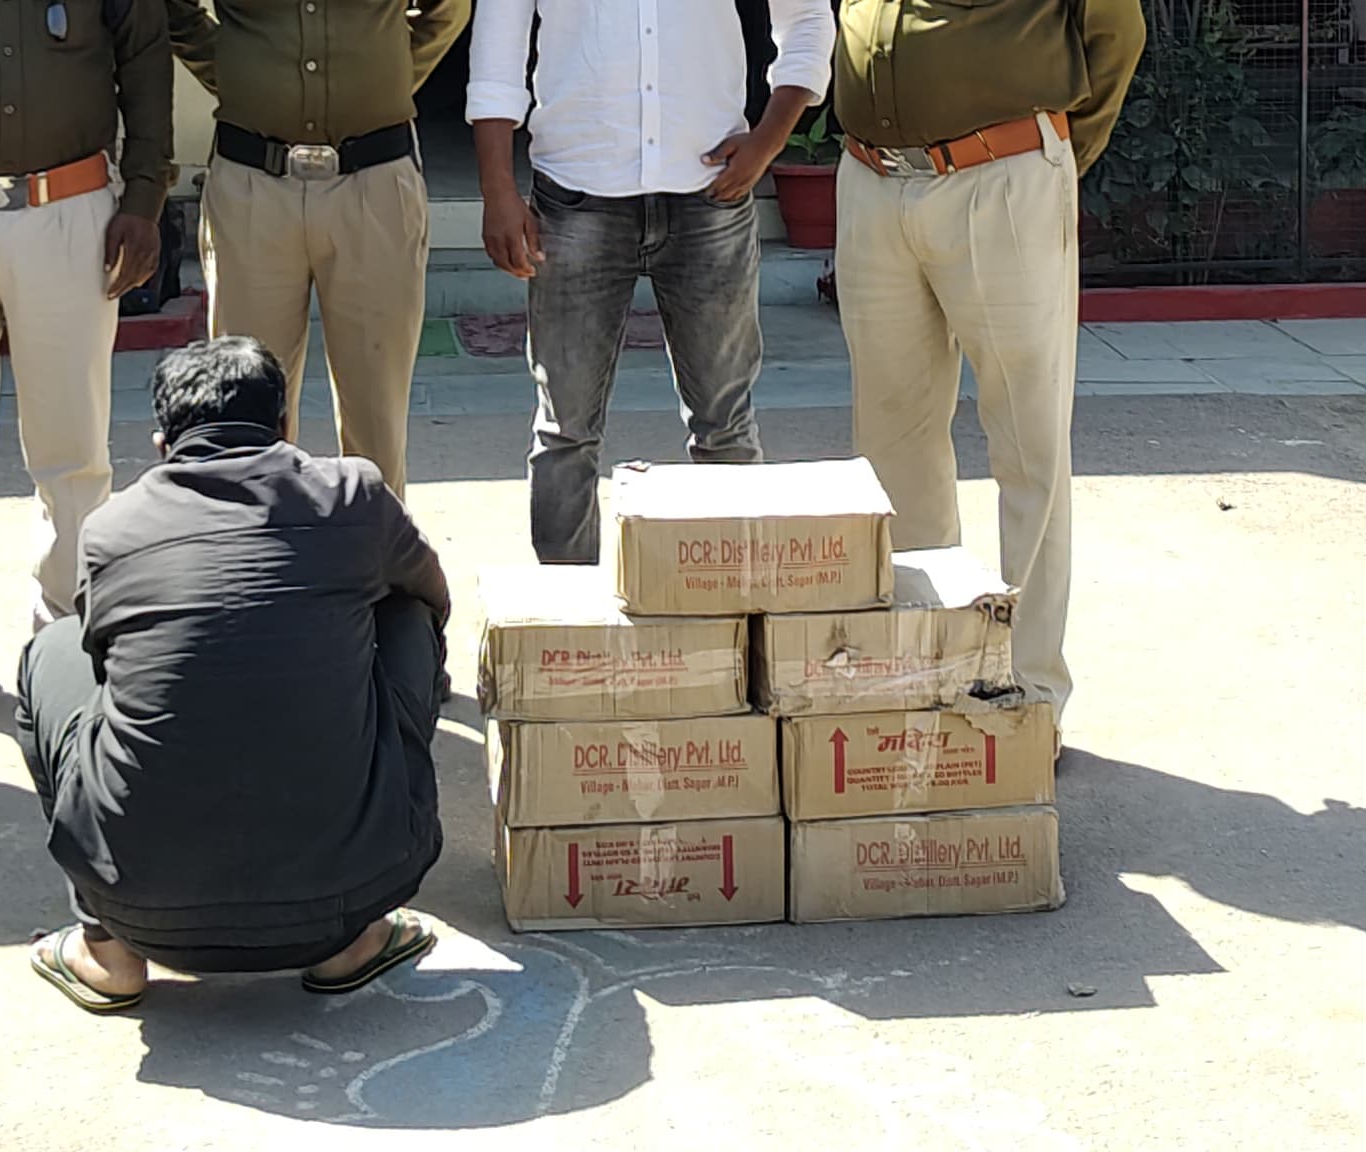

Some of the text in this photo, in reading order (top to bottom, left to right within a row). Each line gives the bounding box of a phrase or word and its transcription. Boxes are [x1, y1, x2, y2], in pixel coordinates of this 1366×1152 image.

[822, 535, 847, 560] Ltd.
[574, 744, 612, 769] DCR.
[686, 740, 713, 765] Pvt.
[719, 739, 745, 764] Ltd.
[857, 841, 893, 866] DCR.
[967, 837, 993, 862] Pvt.
[999, 835, 1024, 859] Ltd.
